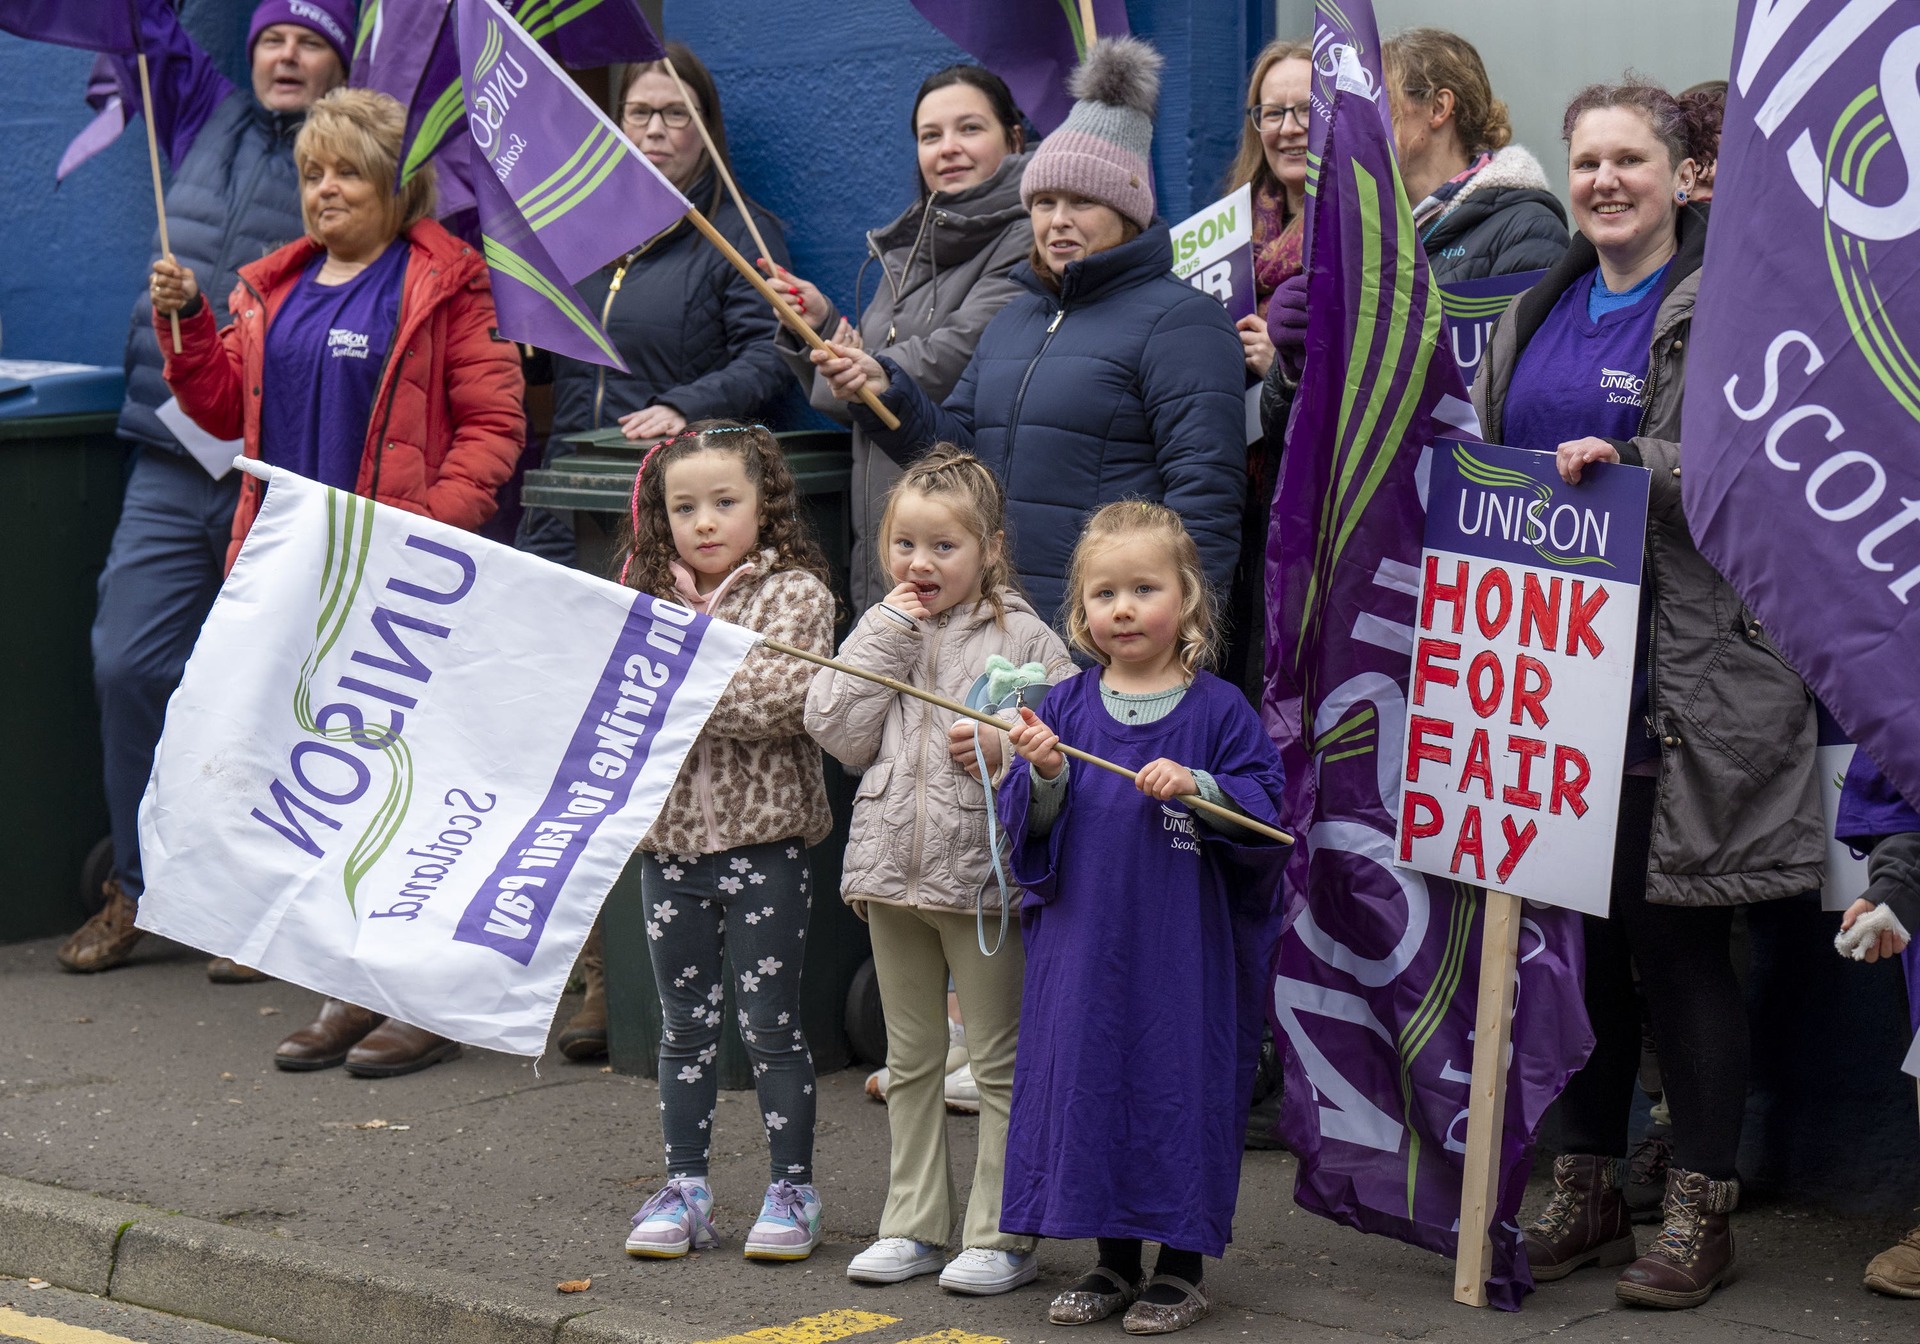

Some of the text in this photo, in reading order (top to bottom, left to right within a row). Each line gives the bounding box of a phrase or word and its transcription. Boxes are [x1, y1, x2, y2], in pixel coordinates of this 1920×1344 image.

[1172, 205, 1236, 266] ISON
[1600, 376, 1645, 392] UNISO
[1606, 392, 1643, 407] Scotla
[1722, 329, 1920, 606] Scot
[1458, 488, 1610, 557] UNISON
[1420, 555, 1610, 660] HONK
[1412, 636, 1552, 730] FOR
[1405, 714, 1591, 819] FAIR
[1163, 816, 1198, 835] UNIS
[1400, 789, 1538, 884] PAY
